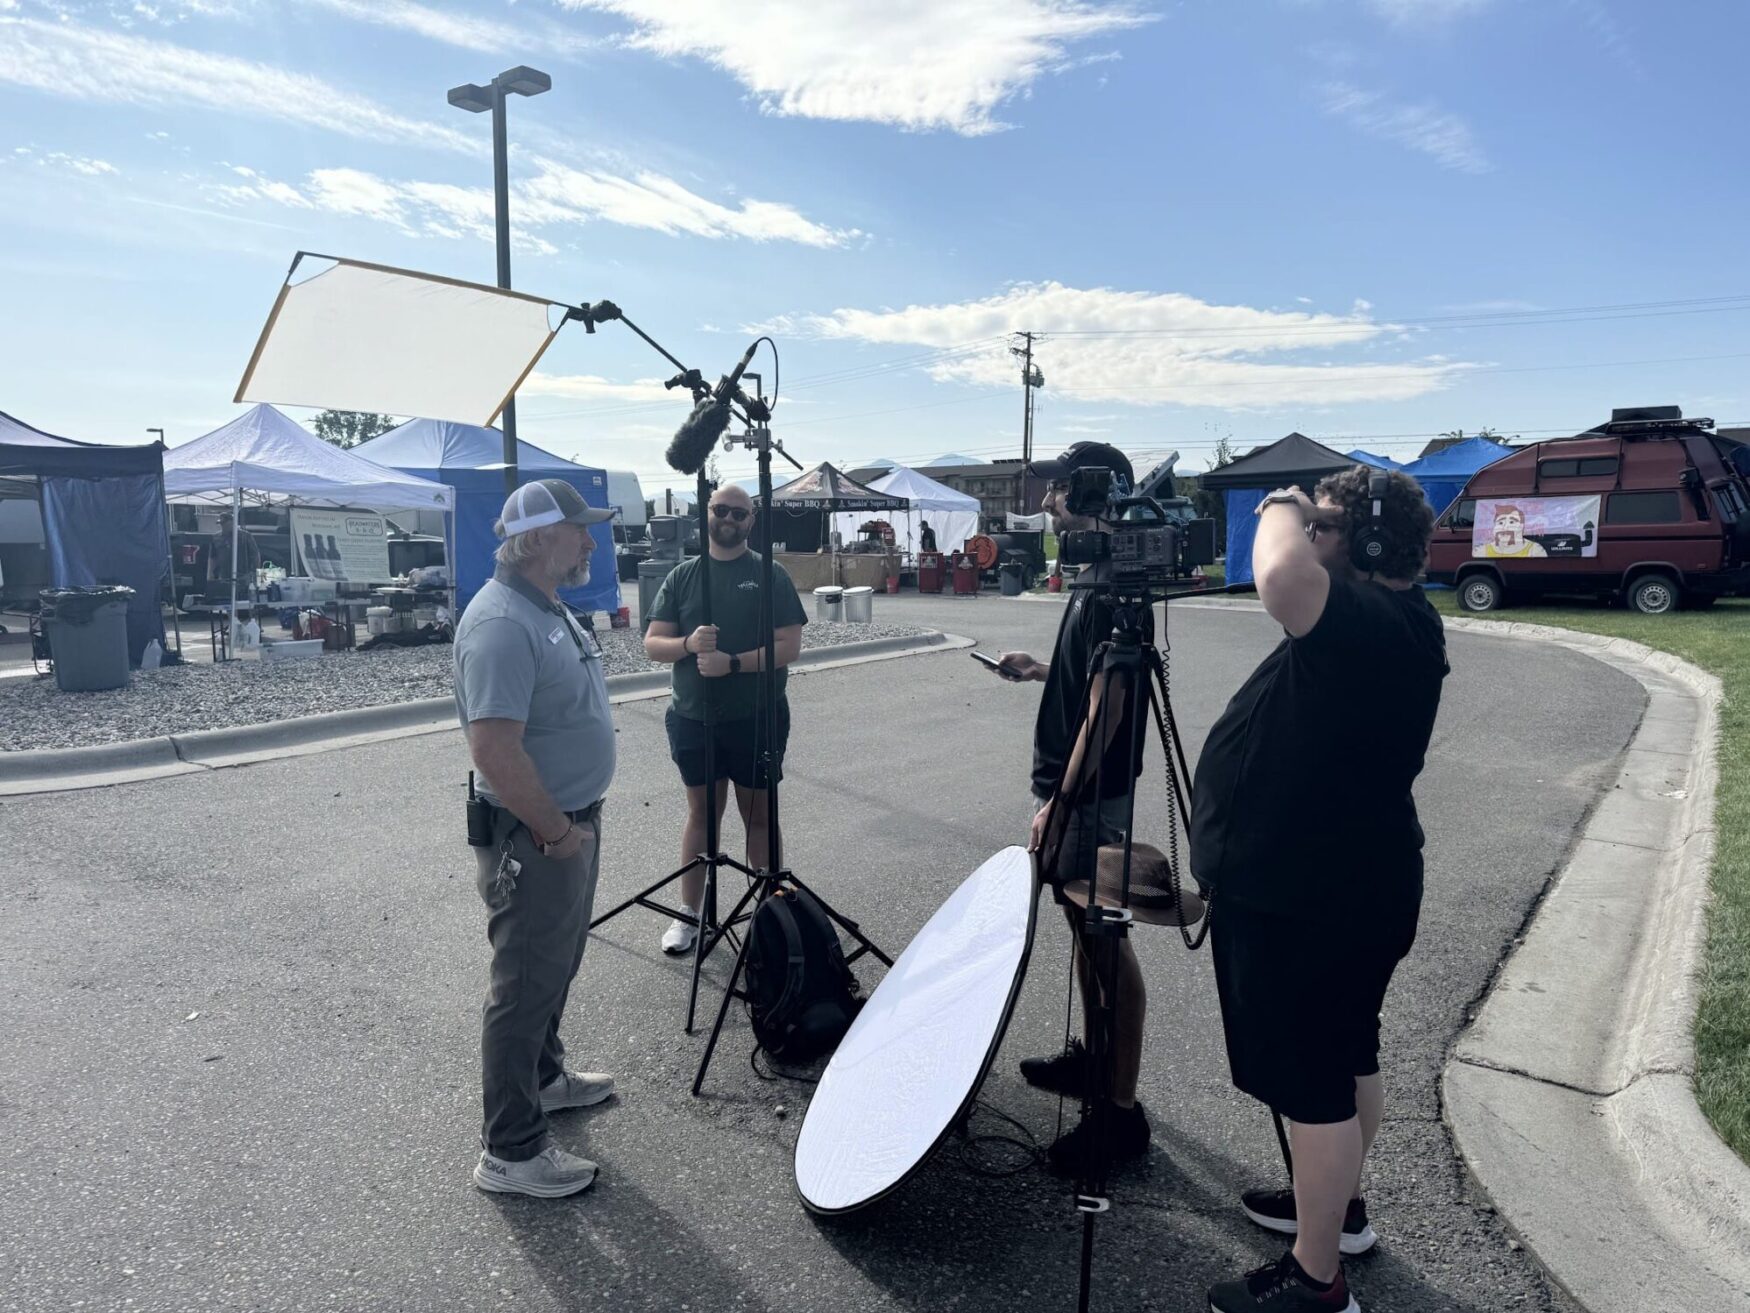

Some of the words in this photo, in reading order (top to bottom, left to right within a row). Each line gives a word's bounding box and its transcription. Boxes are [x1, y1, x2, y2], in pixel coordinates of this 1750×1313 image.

[784, 500, 803, 509] Super
[804, 499, 820, 508] BBQ
[481, 1155, 507, 1177] HOKA
